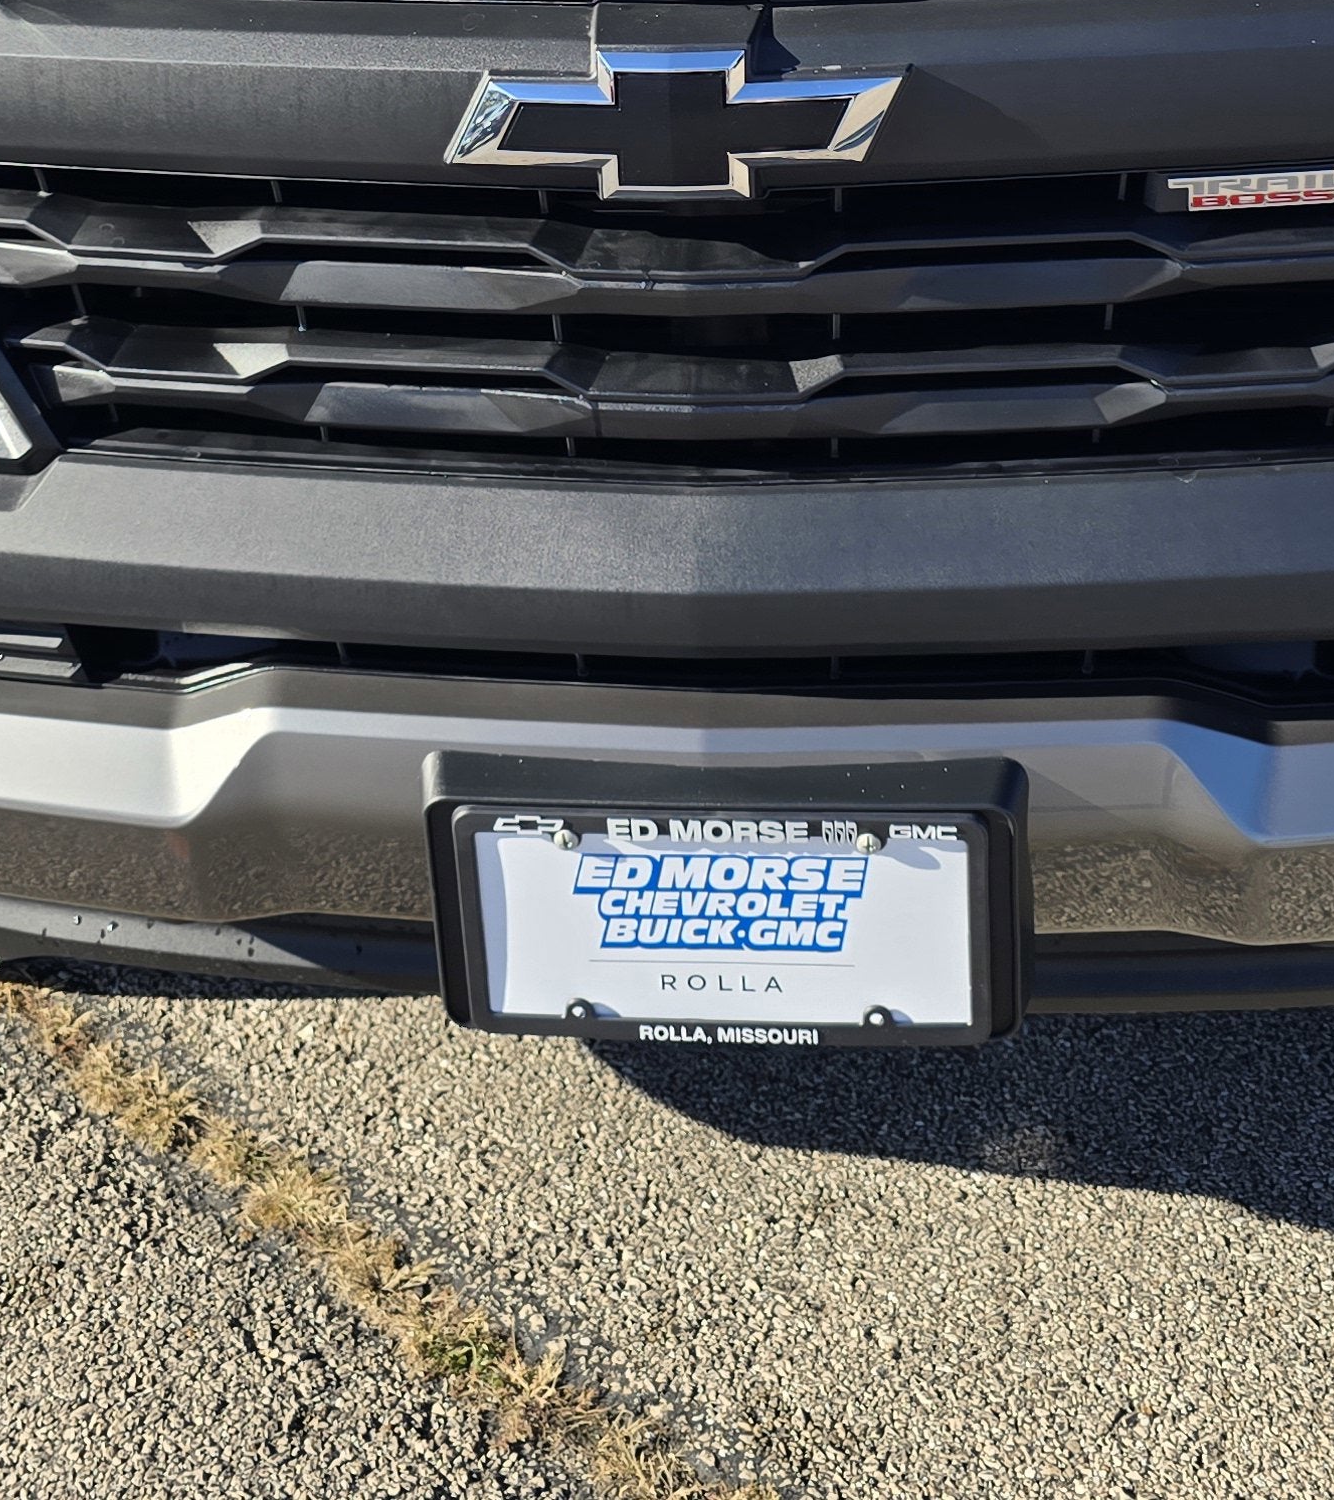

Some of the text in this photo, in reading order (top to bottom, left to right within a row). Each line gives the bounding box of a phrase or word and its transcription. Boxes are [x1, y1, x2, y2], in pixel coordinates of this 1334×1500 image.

[606, 818, 958, 844] ED MORSE GMC
[576, 856, 866, 892] ED MORSE
[600, 891, 845, 919] CHEVROLET
[661, 974, 783, 993] ROLLA
[639, 1025, 819, 1045] ROLLA, MISSOURI
